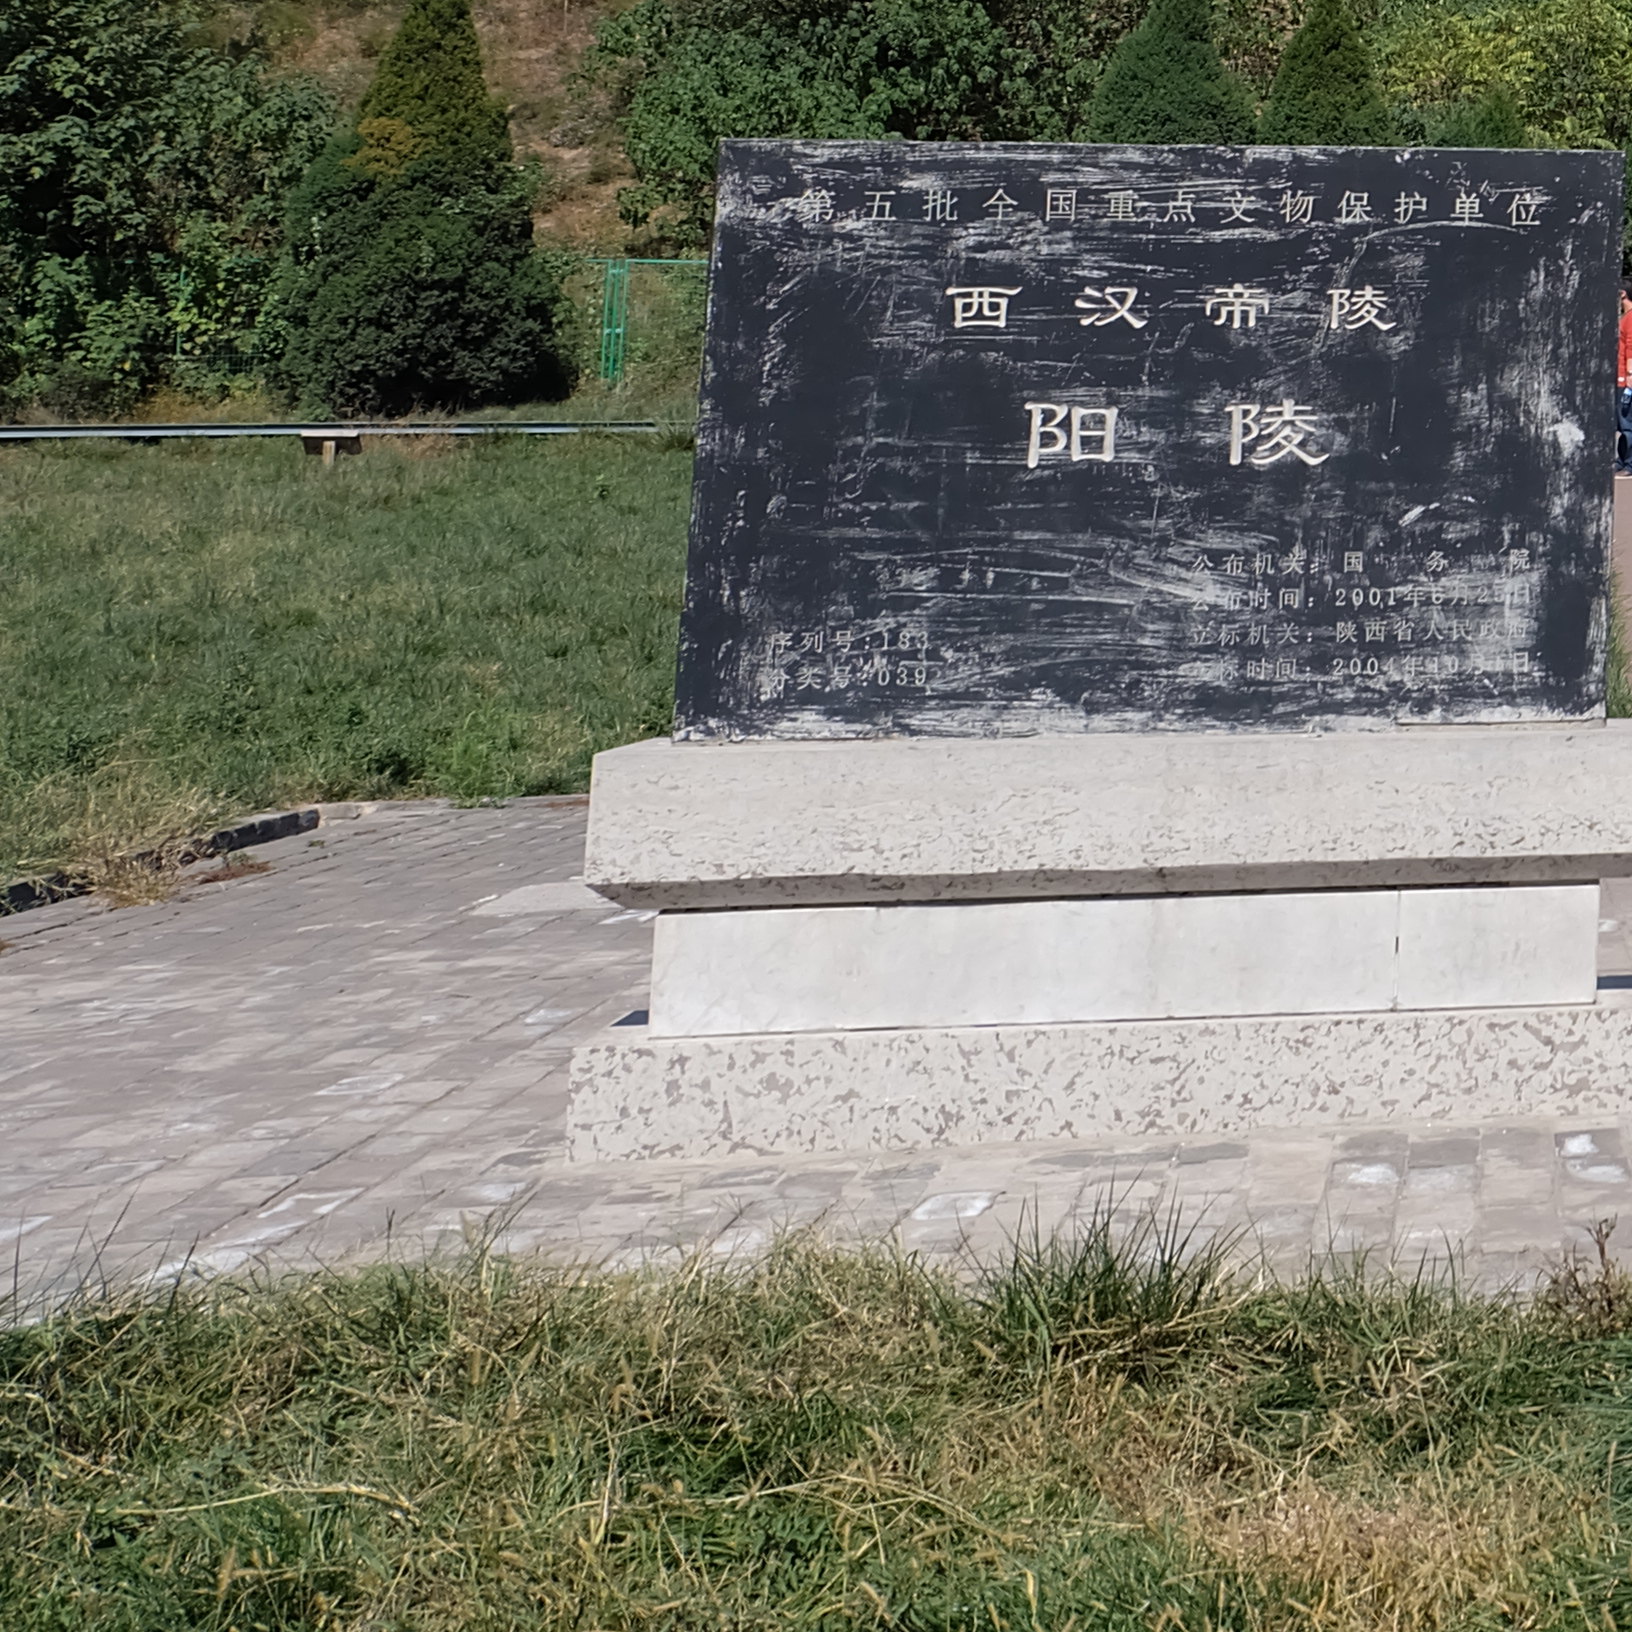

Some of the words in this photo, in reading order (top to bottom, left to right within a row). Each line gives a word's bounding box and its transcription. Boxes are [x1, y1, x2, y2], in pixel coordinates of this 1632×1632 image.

[797, 187, 1541, 226] 第五批全国重点文物保护单位
[945, 282, 1397, 332] 西汉帝陵
[1023, 398, 1330, 469] 阳陵
